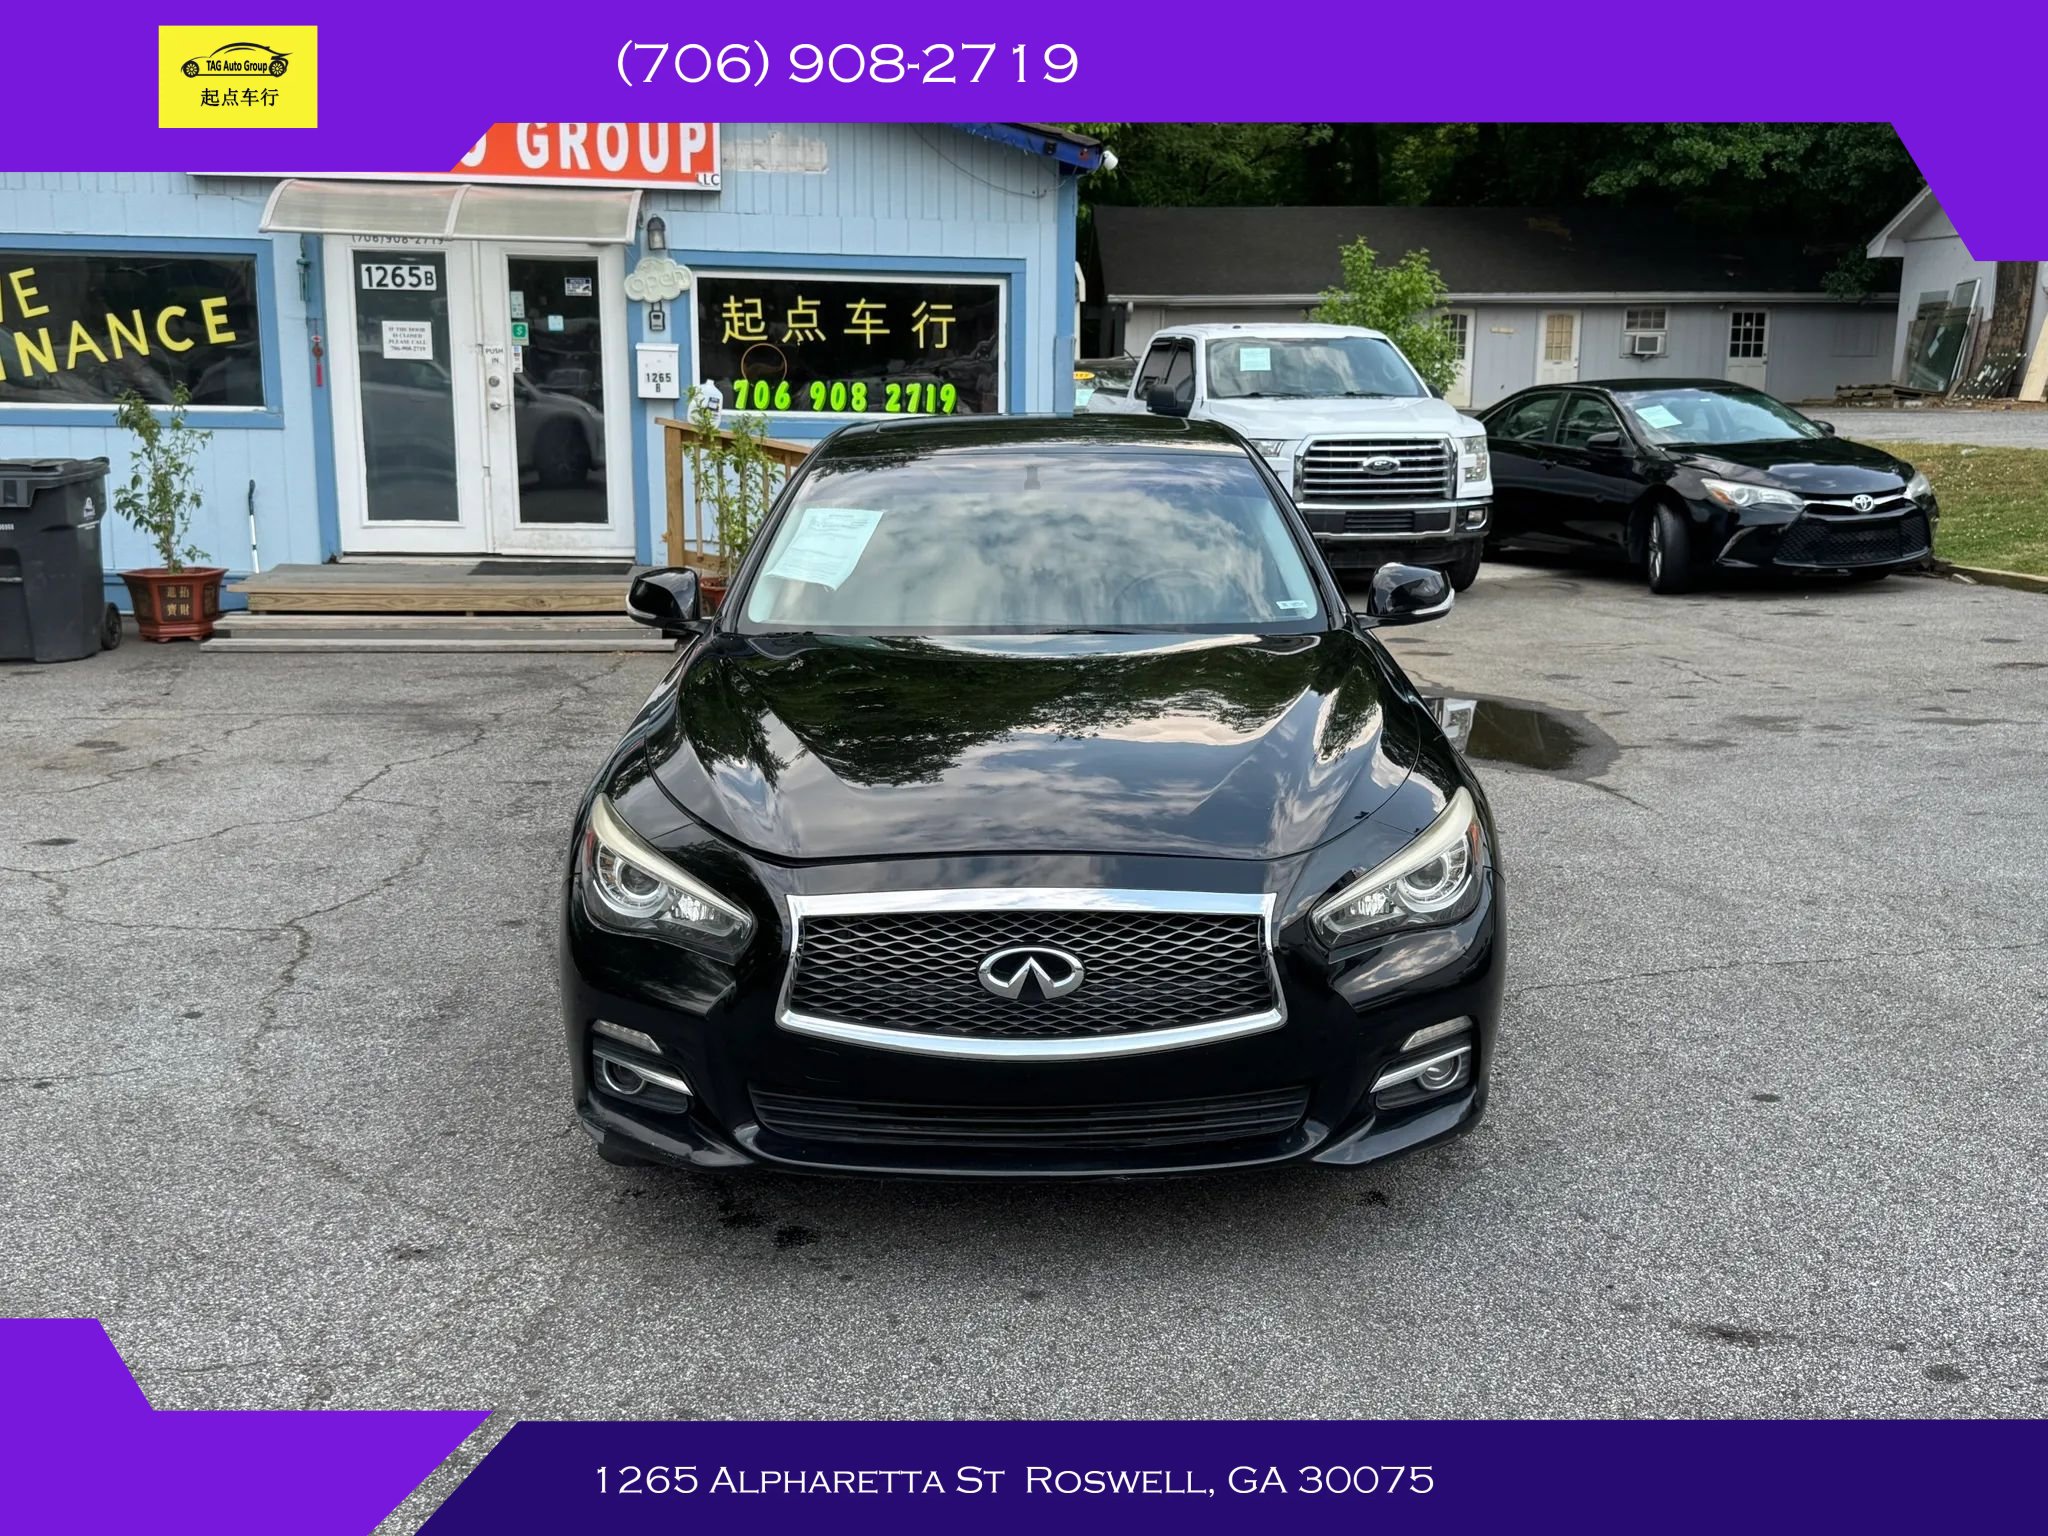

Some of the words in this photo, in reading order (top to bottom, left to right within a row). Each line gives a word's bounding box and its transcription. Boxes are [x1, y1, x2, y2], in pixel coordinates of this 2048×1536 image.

[516, 124, 706, 174] GROUP
[722, 295, 957, 349] 起点车行
[645, 372, 672, 383] 1265
[733, 379, 791, 410] 706
[809, 381, 867, 412] 908
[885, 383, 957, 413] 2719
